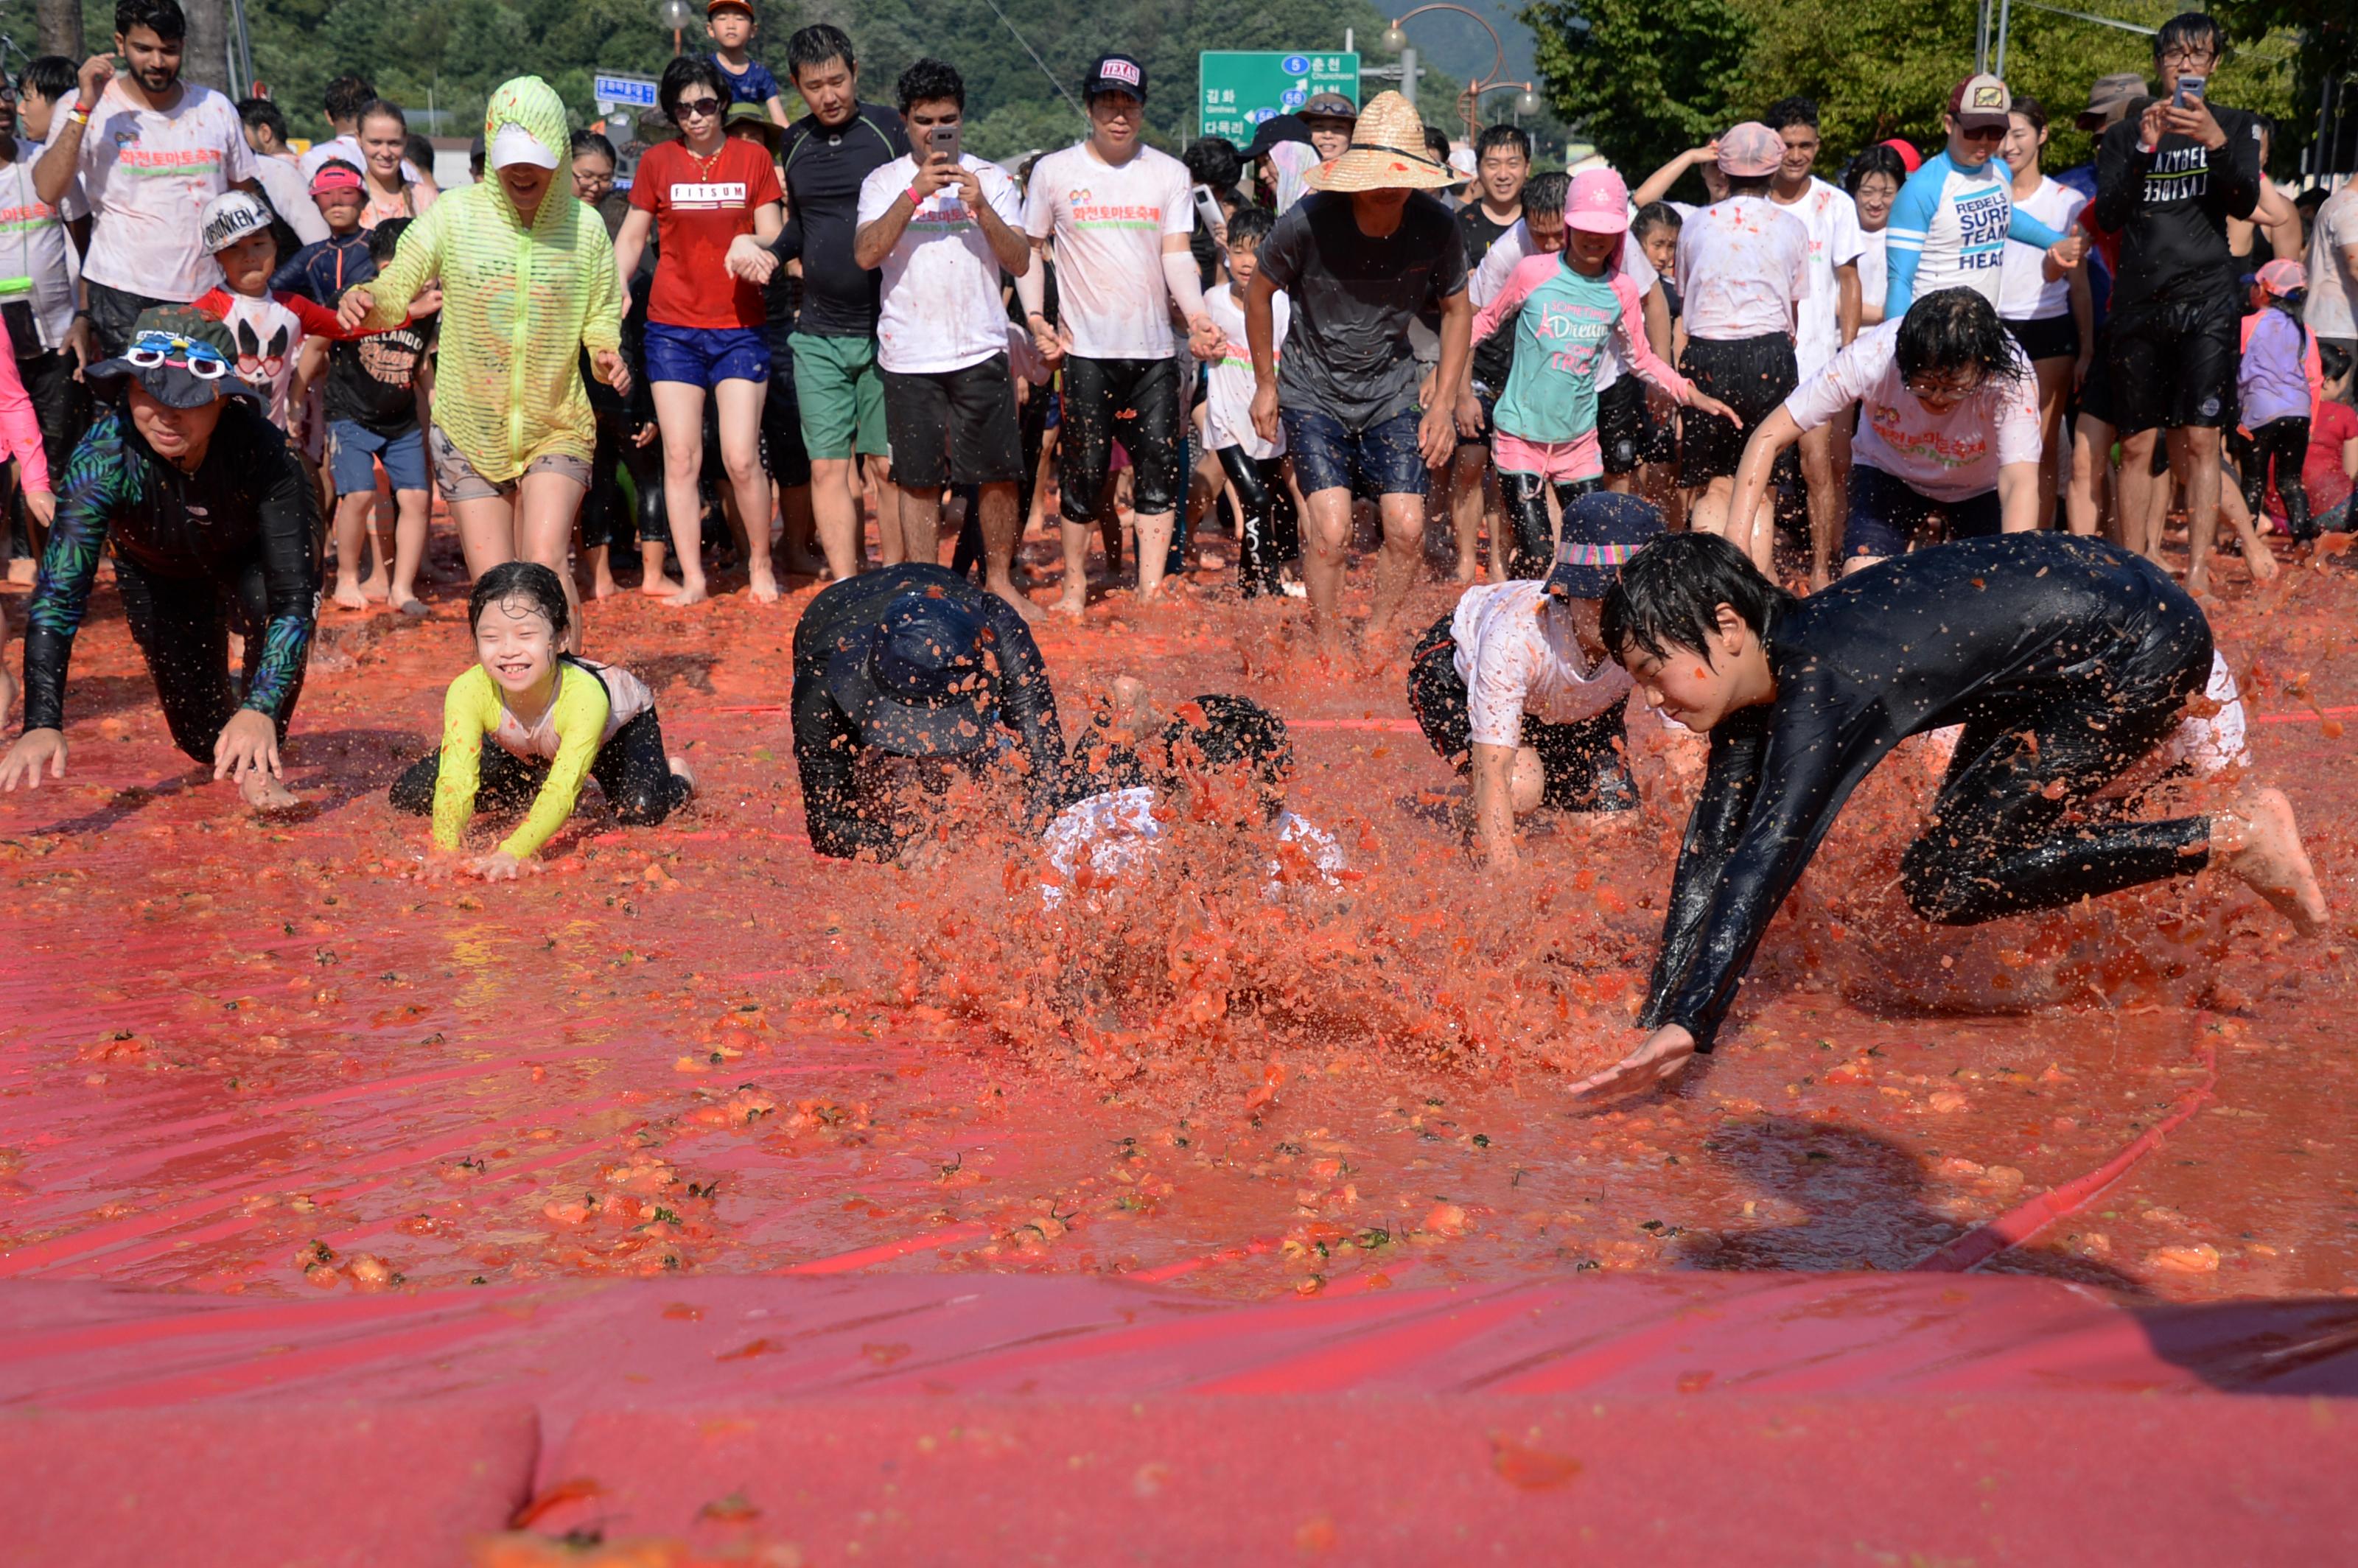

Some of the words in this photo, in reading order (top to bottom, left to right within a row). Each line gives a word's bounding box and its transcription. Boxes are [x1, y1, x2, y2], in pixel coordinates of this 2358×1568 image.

[1106, 63, 1136, 80] TEXAS
[1291, 58, 1301, 71] 5
[1312, 57, 1340, 71] 춘천
[1206, 88, 1235, 103] 김화
[1285, 91, 1302, 104] 56
[1204, 120, 1243, 135] 다목리
[675, 186, 743, 198] FITSUM
[1956, 192, 2007, 214] REBELS
[1072, 205, 1160, 223] 화천토마토축제
[1960, 205, 2009, 231] SURF
[1960, 223, 2009, 246] TEAM
